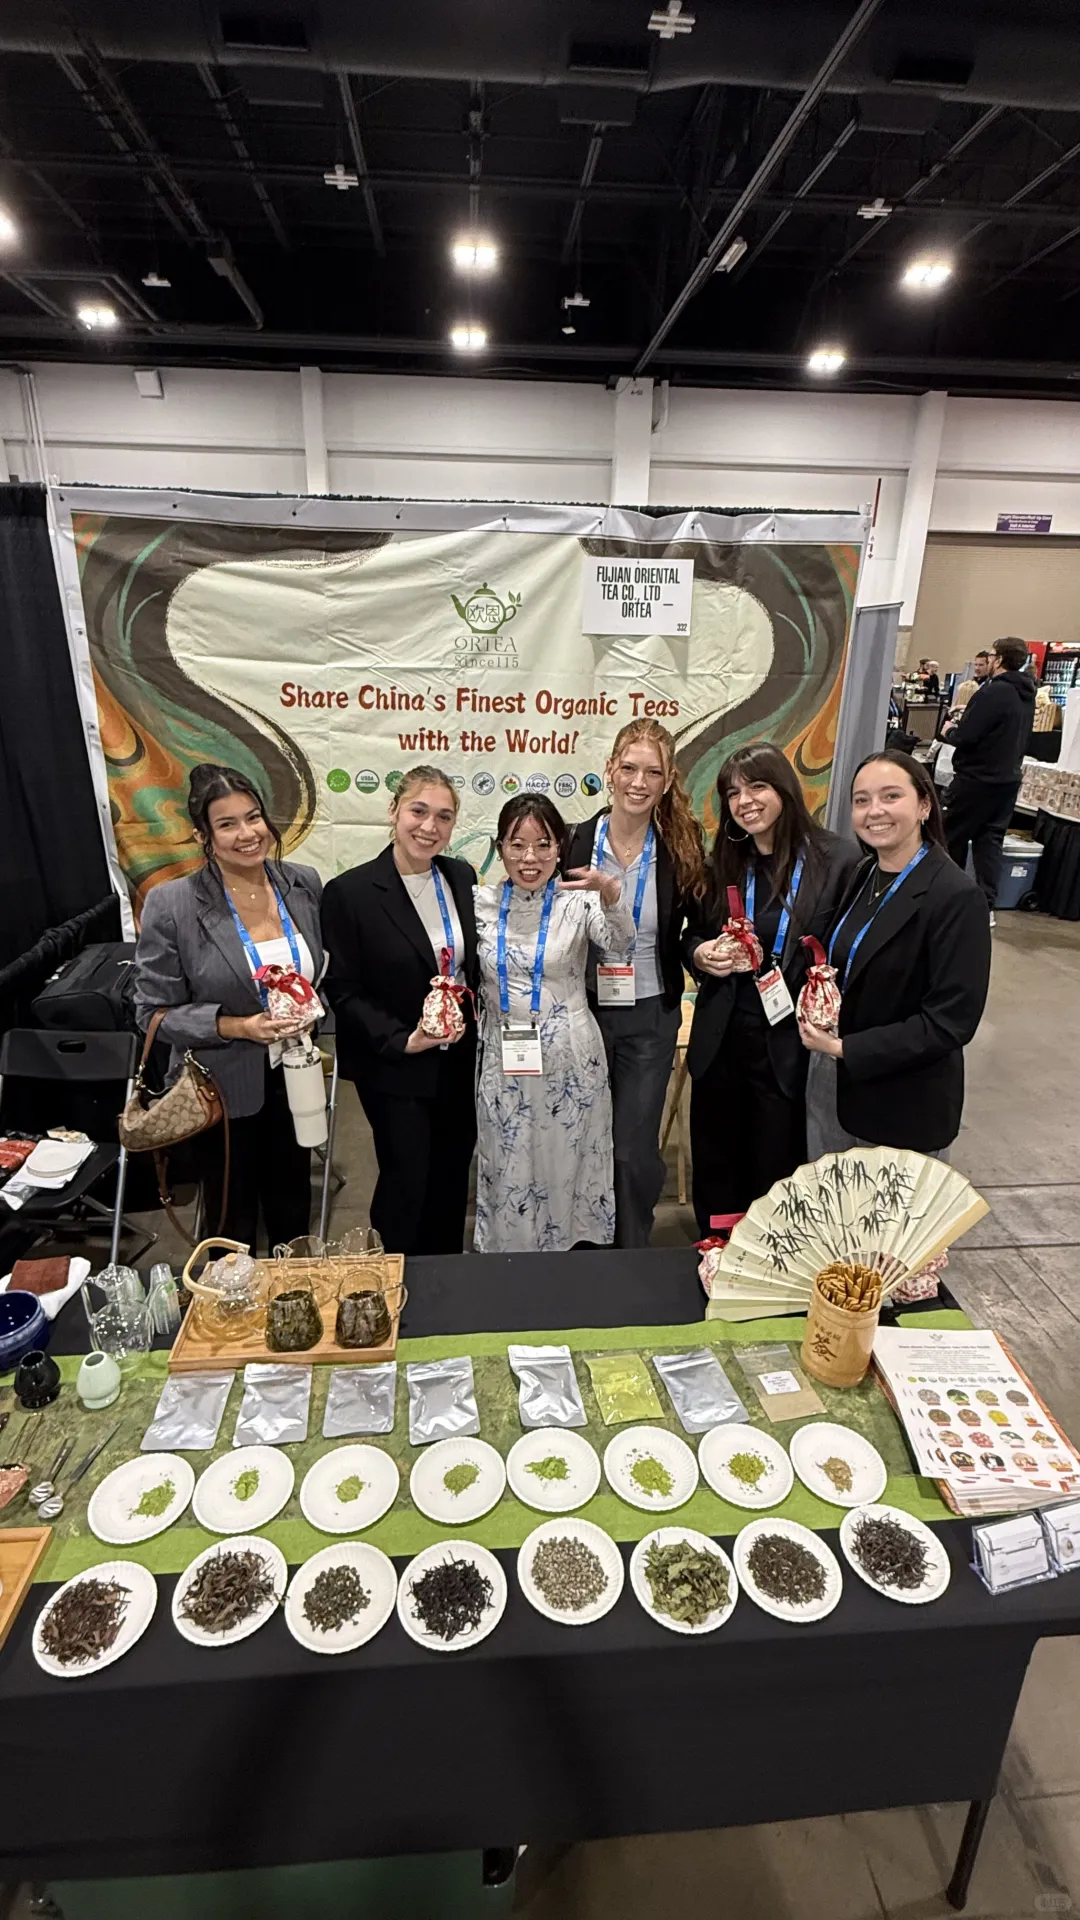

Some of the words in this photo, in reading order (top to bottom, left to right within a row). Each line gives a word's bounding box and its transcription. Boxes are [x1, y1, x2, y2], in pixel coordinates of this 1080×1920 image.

[596, 565, 632, 584] FUJIAN
[634, 567, 681, 584] ORIENTAL
[601, 584, 619, 601] TEA
[621, 584, 641, 604] CO.,
[643, 585, 661, 601] LTD
[467, 604, 502, 624] 欧恩
[621, 601, 652, 618] ORTEA
[676, 622, 688, 632] 332
[454, 635, 518, 653] ORTEA
[279, 682, 349, 709] Share
[358, 684, 447, 712] China's
[455, 687, 527, 714] Finest
[535, 689, 618, 720] Organic
[628, 692, 680, 717] Teas
[397, 727, 450, 752] with
[459, 730, 497, 753] the
[505, 729, 580, 754] World!
[525, 781, 551, 789] HACCP
